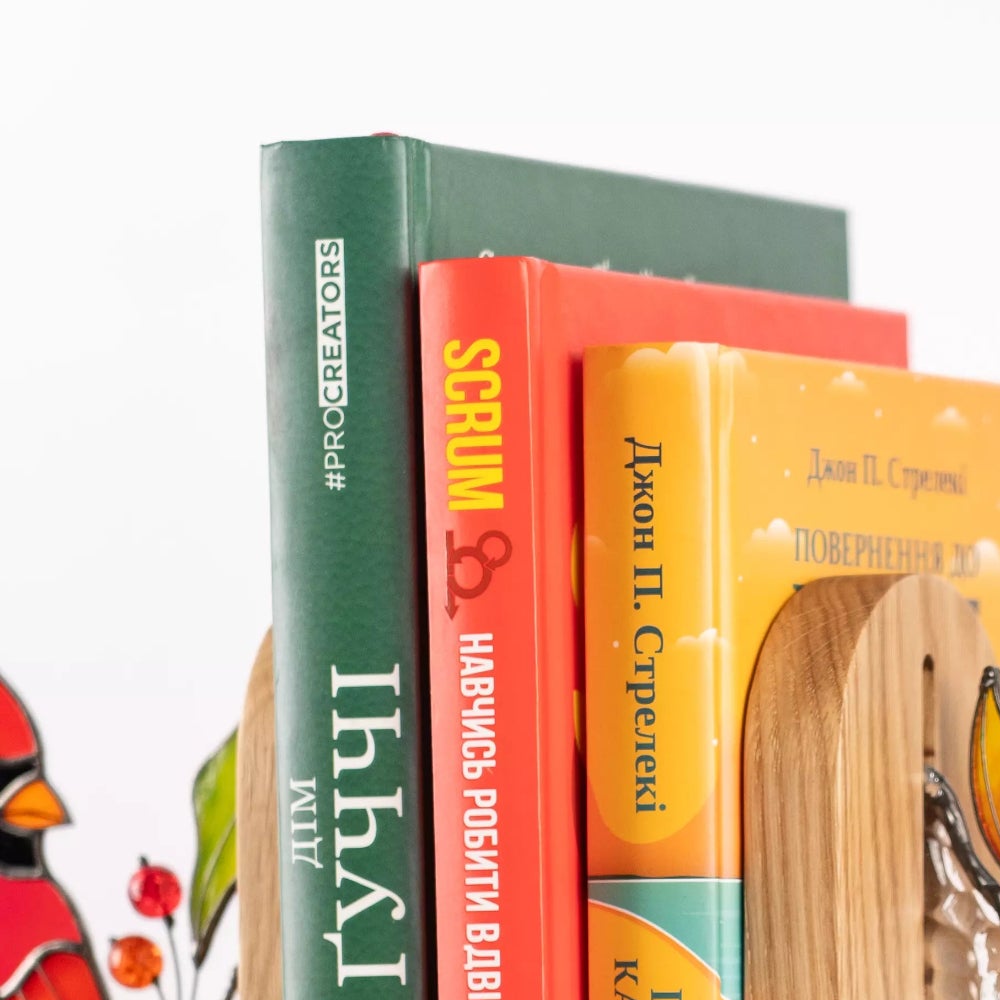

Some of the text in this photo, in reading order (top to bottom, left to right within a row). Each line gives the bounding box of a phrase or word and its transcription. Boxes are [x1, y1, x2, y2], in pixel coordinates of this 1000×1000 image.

[317, 239, 347, 491] #PROCREATORS
[443, 338, 504, 511] SCRUM
[624, 436, 666, 813] Джон П. Стрелекі
[458, 632, 497, 781] НАВЧИСЬ
[289, 776, 323, 869] ДІМ
[463, 788, 501, 912] РОБИТИ
